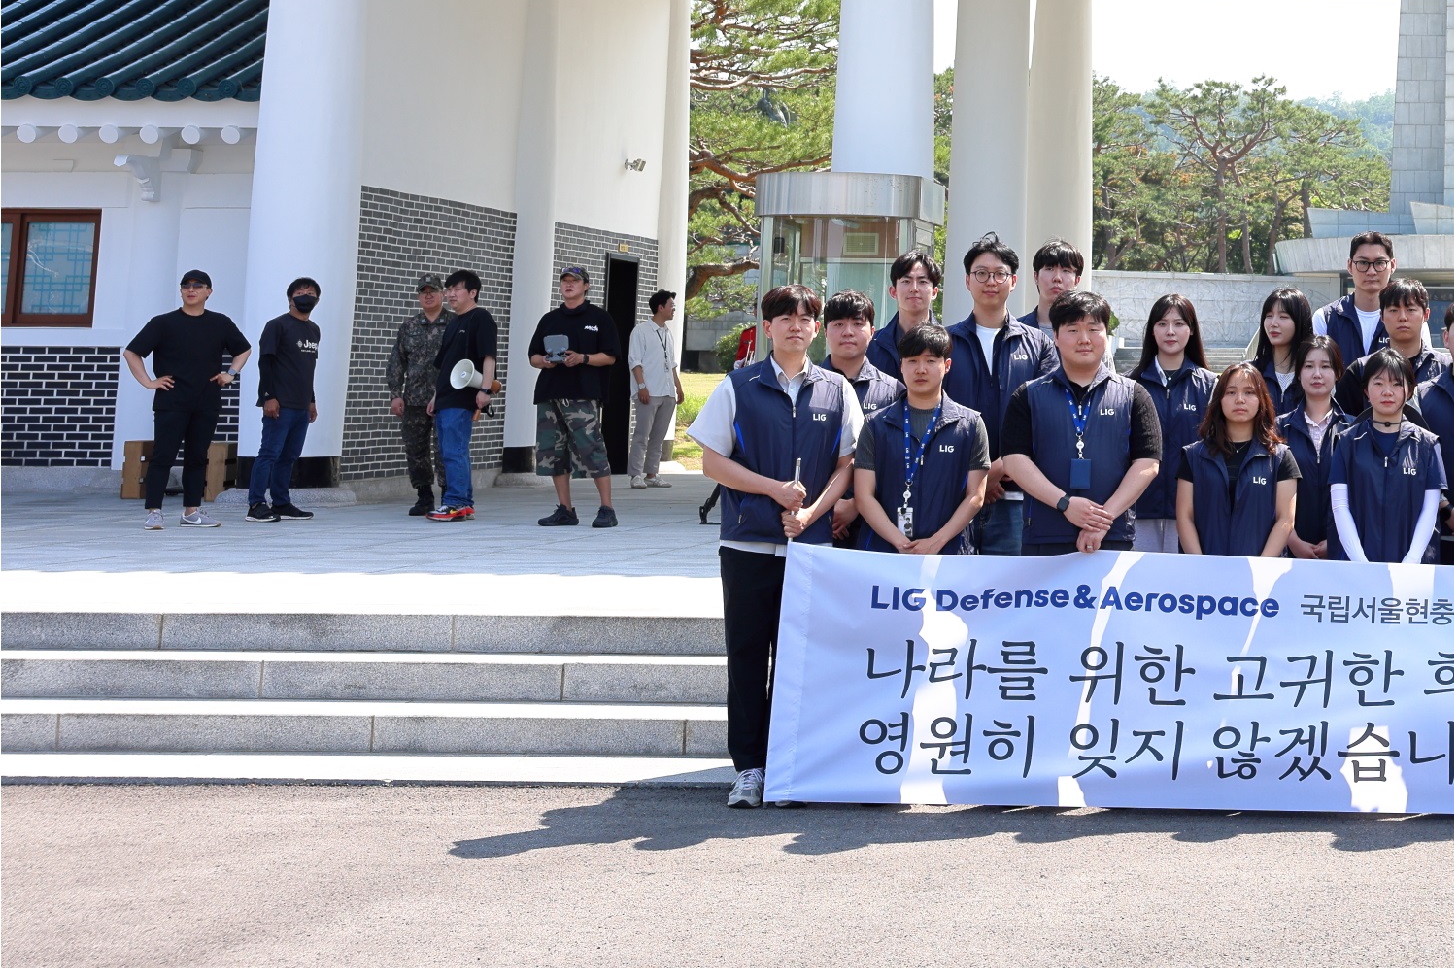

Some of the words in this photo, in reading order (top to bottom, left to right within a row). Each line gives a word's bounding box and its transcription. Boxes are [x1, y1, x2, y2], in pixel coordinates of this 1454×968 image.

[863, 402, 877, 411] LIG
[1183, 403, 1197, 412] LIG
[1100, 408, 1115, 416] LIG
[812, 413, 827, 422] LIG
[939, 444, 955, 454] LIG
[1402, 467, 1417, 476] LIG
[1252, 476, 1267, 486] LIG
[870, 585, 926, 612] LIG
[865, 638, 1049, 702] 나라를
[1068, 641, 1197, 706] 위한
[1212, 649, 1405, 709] 고귀한
[858, 712, 1035, 779] 영원히
[1069, 718, 1184, 781] 잊지
